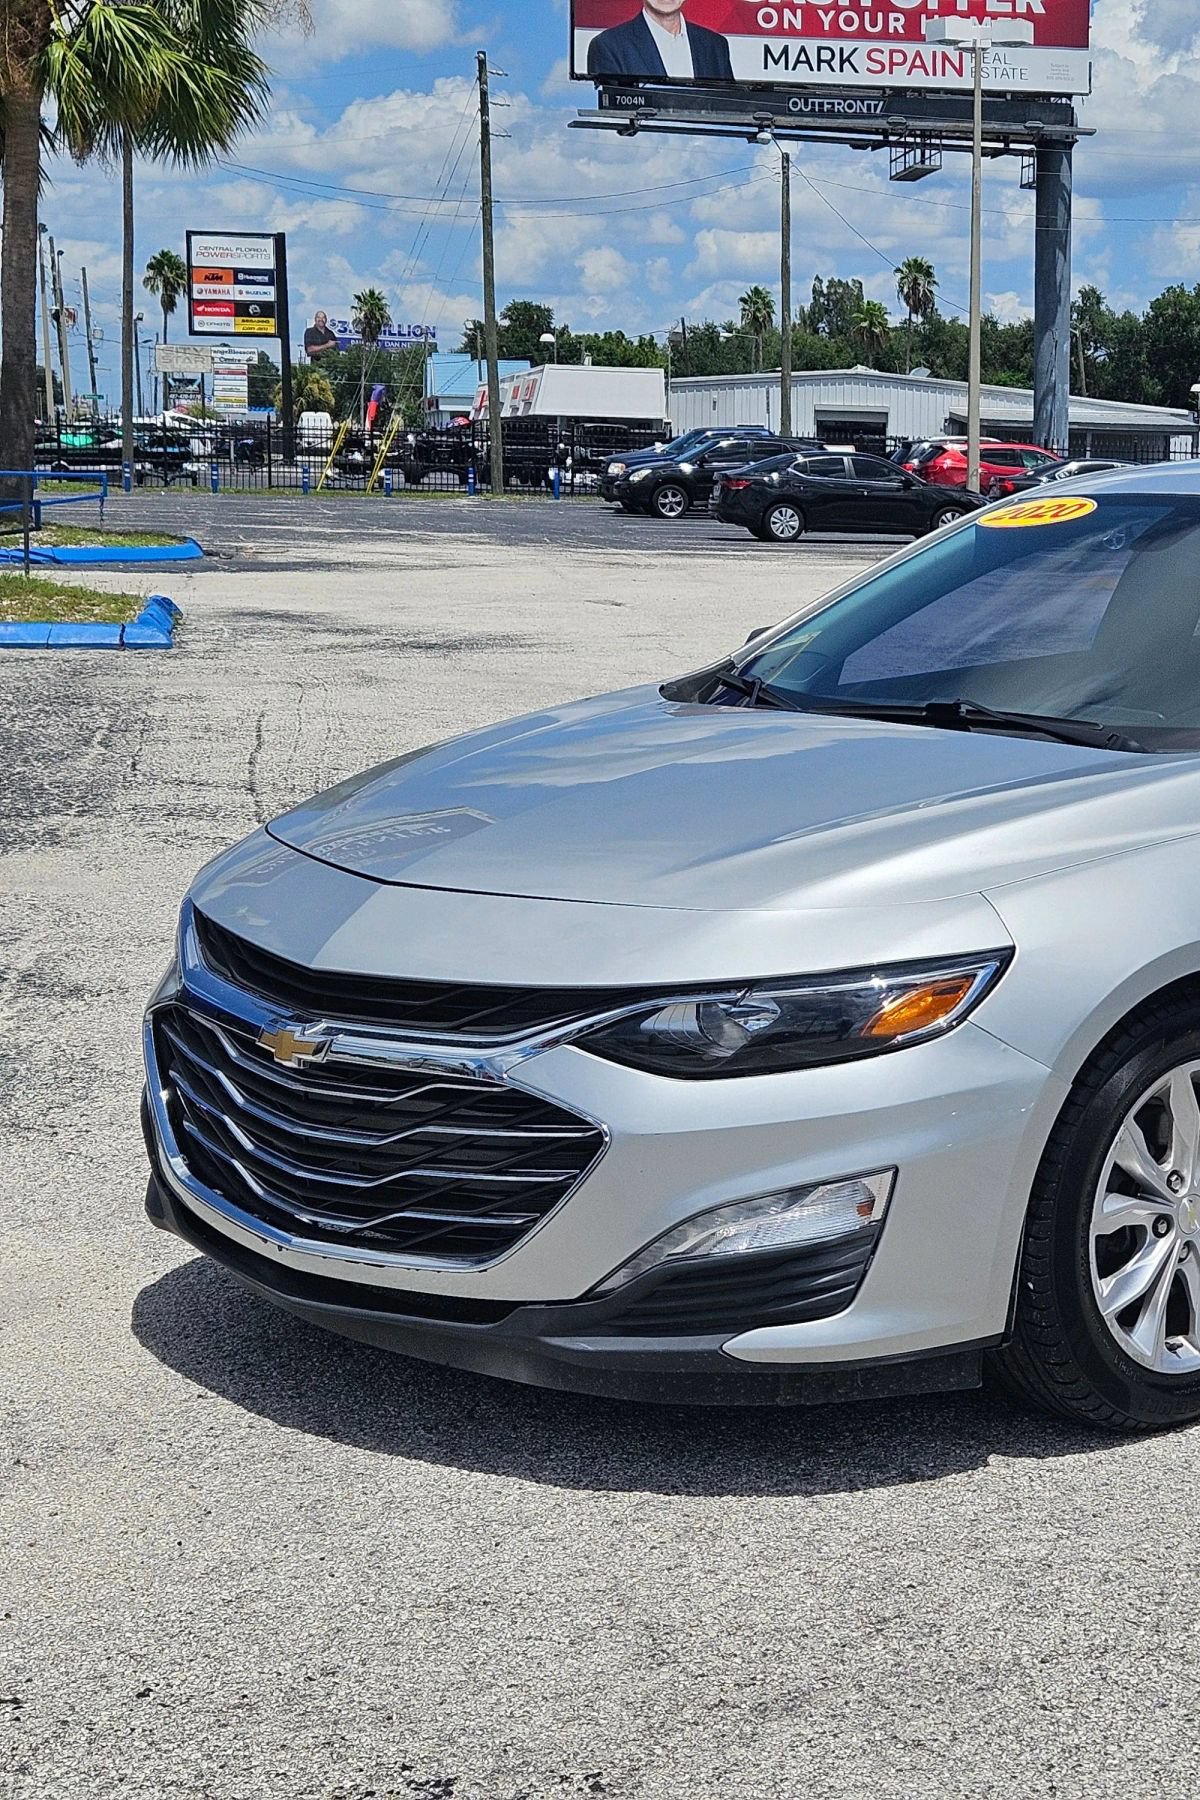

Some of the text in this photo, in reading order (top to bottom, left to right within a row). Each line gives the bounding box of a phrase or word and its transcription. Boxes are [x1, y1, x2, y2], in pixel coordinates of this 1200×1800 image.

[756, 7, 801, 30] ON
[816, 9, 905, 34] YOUR
[762, 43, 964, 78] MARK SPAIN
[970, 67, 1029, 81] ESTATE
[615, 95, 645, 105] 7004N
[195, 251, 271, 260] POWERSPORTS
[203, 272, 224, 281] KTM
[204, 287, 231, 296] YAMAHA
[379, 323, 436, 338] ILLION
[980, 503, 1088, 522] 2020
